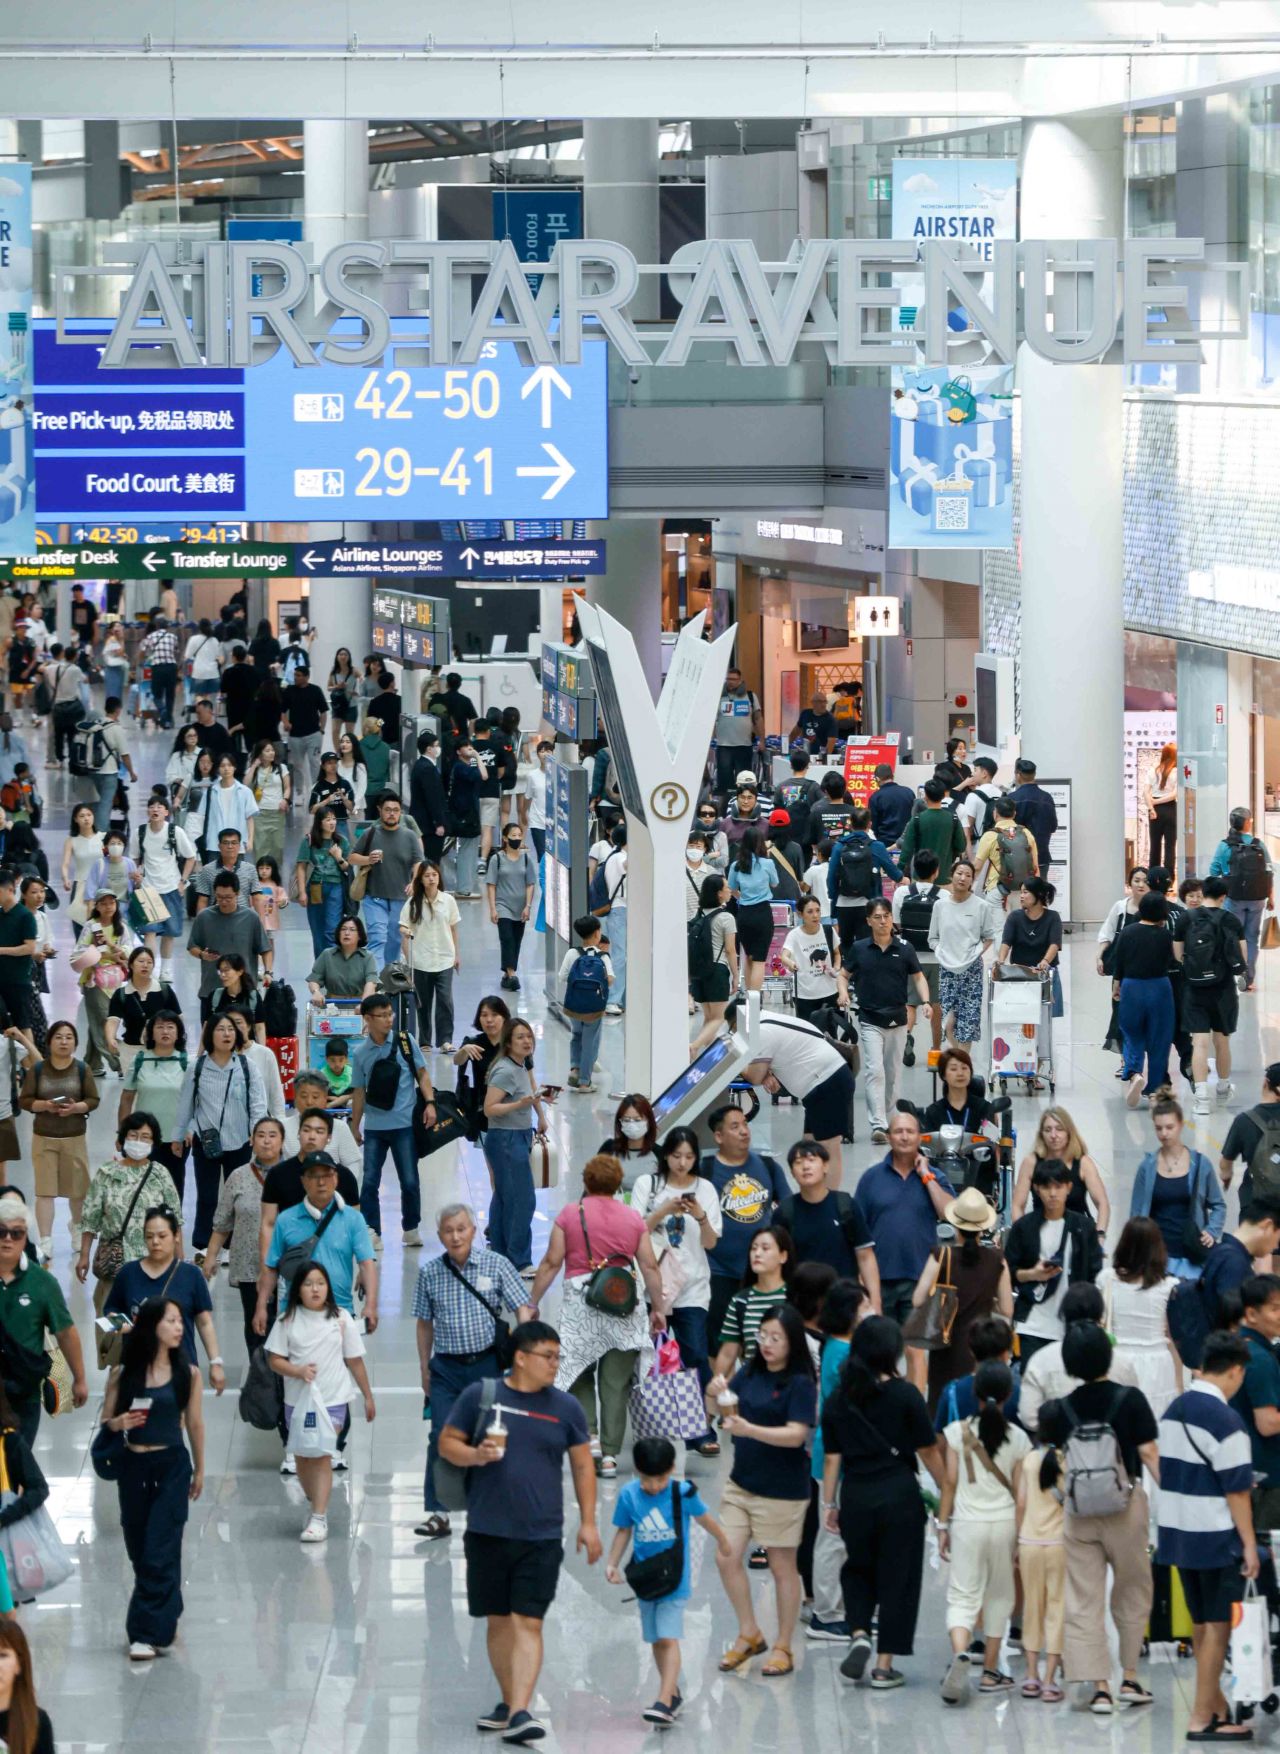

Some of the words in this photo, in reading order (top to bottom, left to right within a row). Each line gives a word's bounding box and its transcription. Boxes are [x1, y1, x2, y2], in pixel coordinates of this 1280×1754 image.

[526, 213, 539, 248] FOOD
[913, 216, 995, 238] AIRSTAR
[98, 239, 653, 368] AIRSTAR
[656, 238, 1206, 366] AVENUE
[354, 370, 500, 419] 42-50
[32, 411, 67, 430] Free
[70, 410, 136, 434] Pick-up,
[138, 410, 235, 430] 免税品领取处
[86, 473, 130, 493] Food
[132, 473, 183, 494] Court,
[185, 472, 236, 494] 美食街
[354, 447, 493, 497] 29-41
[88, 527, 139, 543] 42-50
[80, 550, 119, 565] Desk
[171, 552, 231, 568] Transfer
[233, 551, 287, 571] Lounge
[331, 547, 380, 563] Airline
[382, 547, 443, 565] Lounges
[40, 566, 75, 576] Airlines
[384, 565, 417, 573] Singapore
